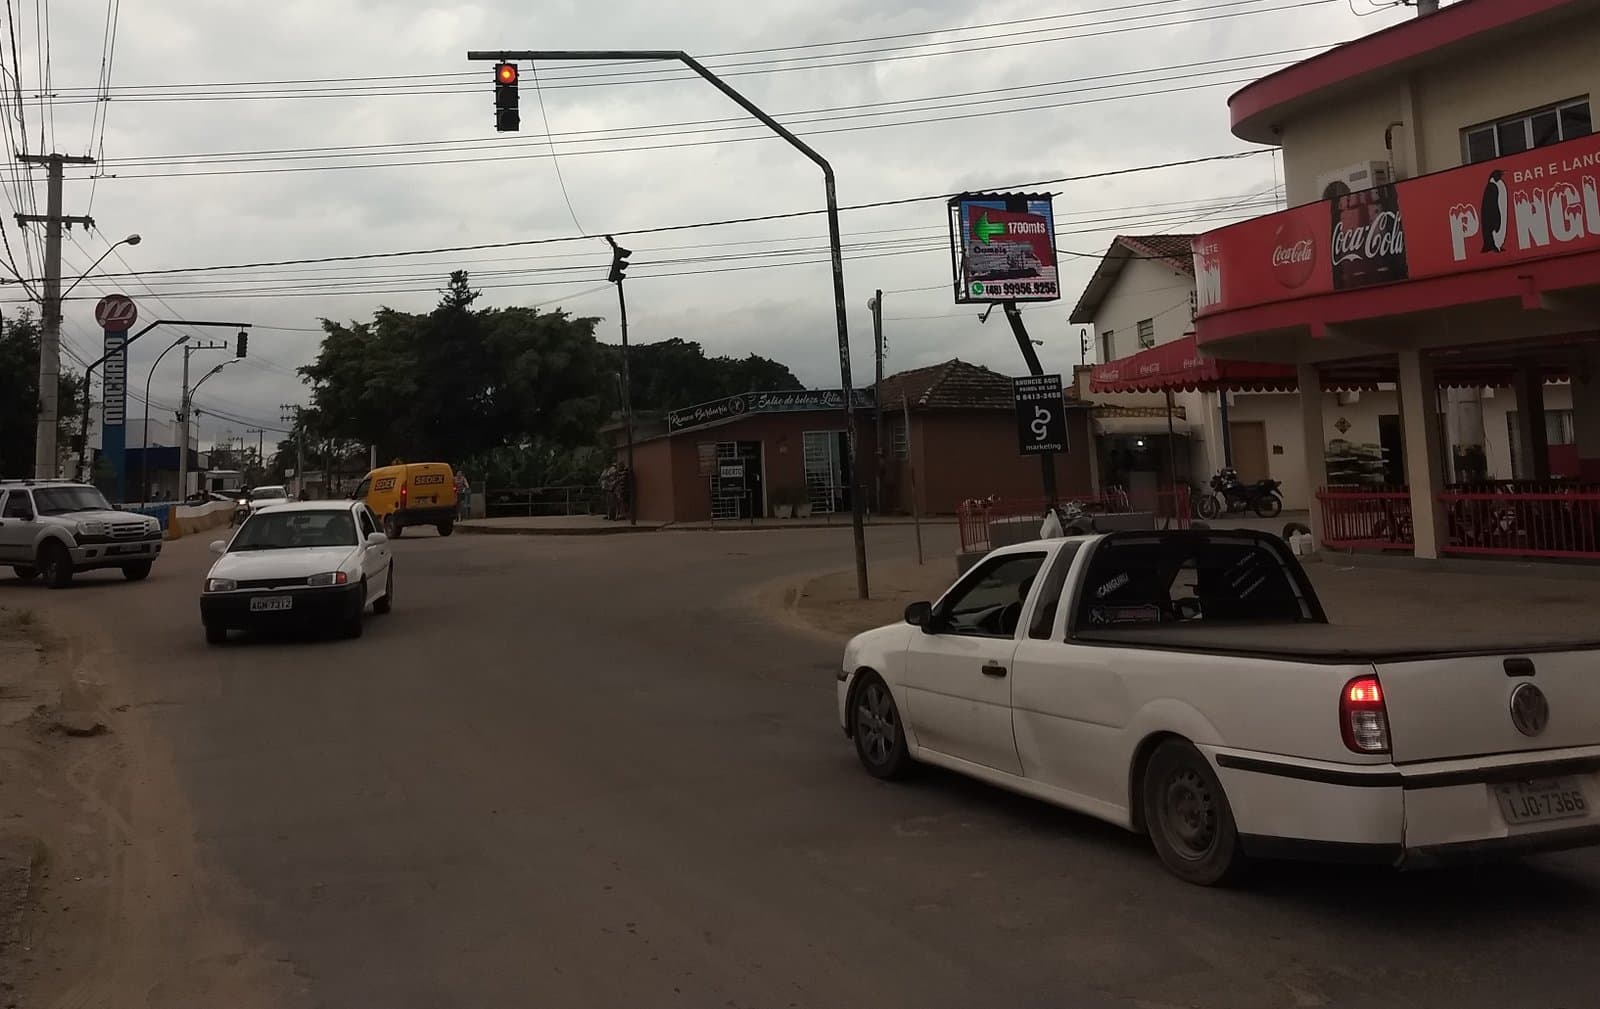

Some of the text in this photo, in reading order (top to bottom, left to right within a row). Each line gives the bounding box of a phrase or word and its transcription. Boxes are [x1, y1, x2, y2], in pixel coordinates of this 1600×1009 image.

[1513, 166, 1544, 183] BAR
[1549, 163, 1558, 175] E
[1008, 222, 1046, 234] 1700mts
[1332, 211, 1404, 266] Coca-Cola
[1273, 240, 1313, 266] Coca-Cola
[103, 337, 125, 425] MACHADO
[415, 475, 444, 485] SEDEX
